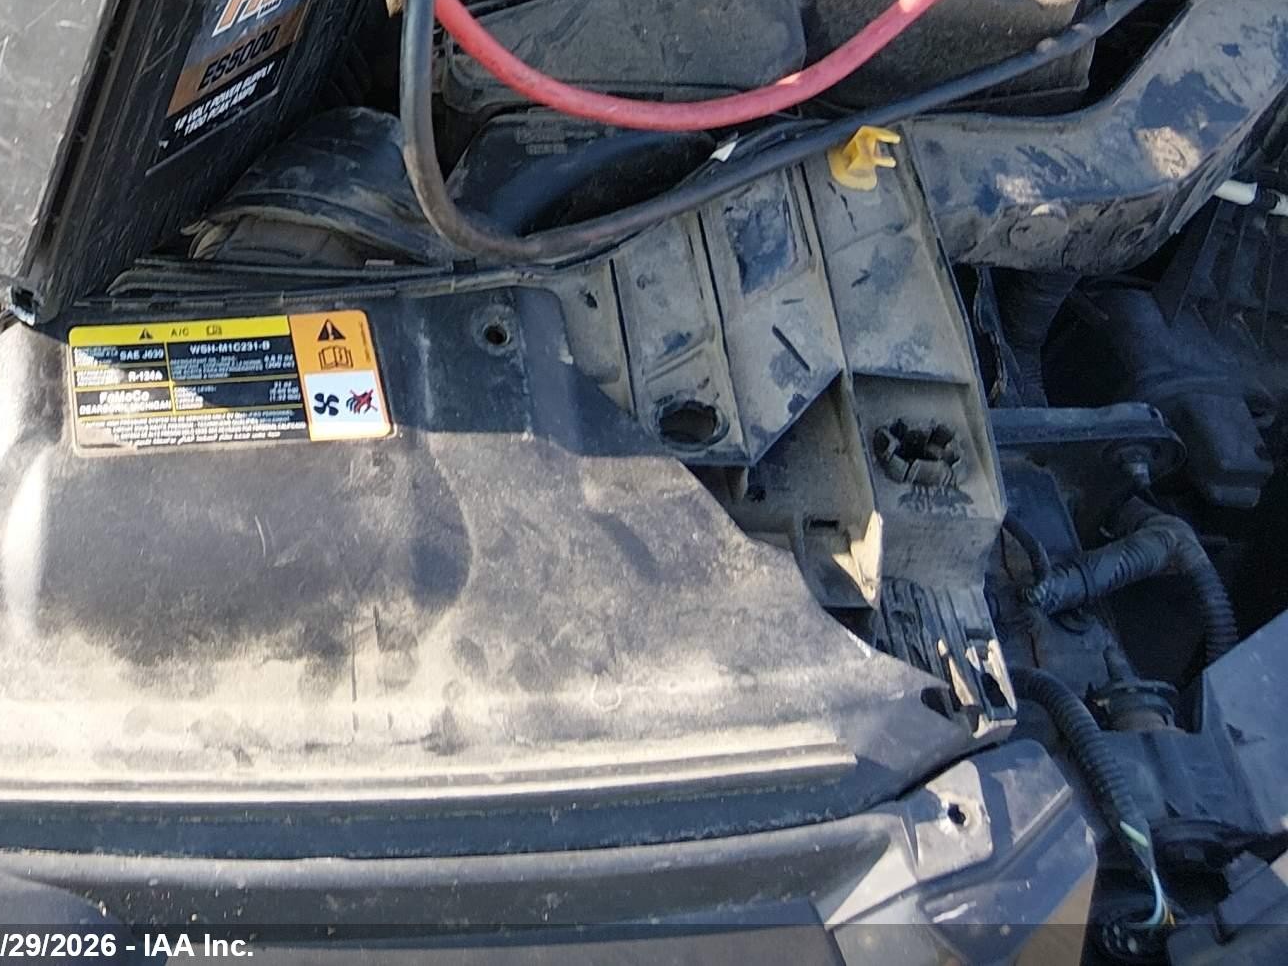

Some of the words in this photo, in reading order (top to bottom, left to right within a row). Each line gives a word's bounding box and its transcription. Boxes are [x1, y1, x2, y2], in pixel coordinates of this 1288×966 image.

[197, 24, 280, 91] ES5000
[172, 327, 189, 338] A/C
[99, 390, 150, 405] FoMoCo
